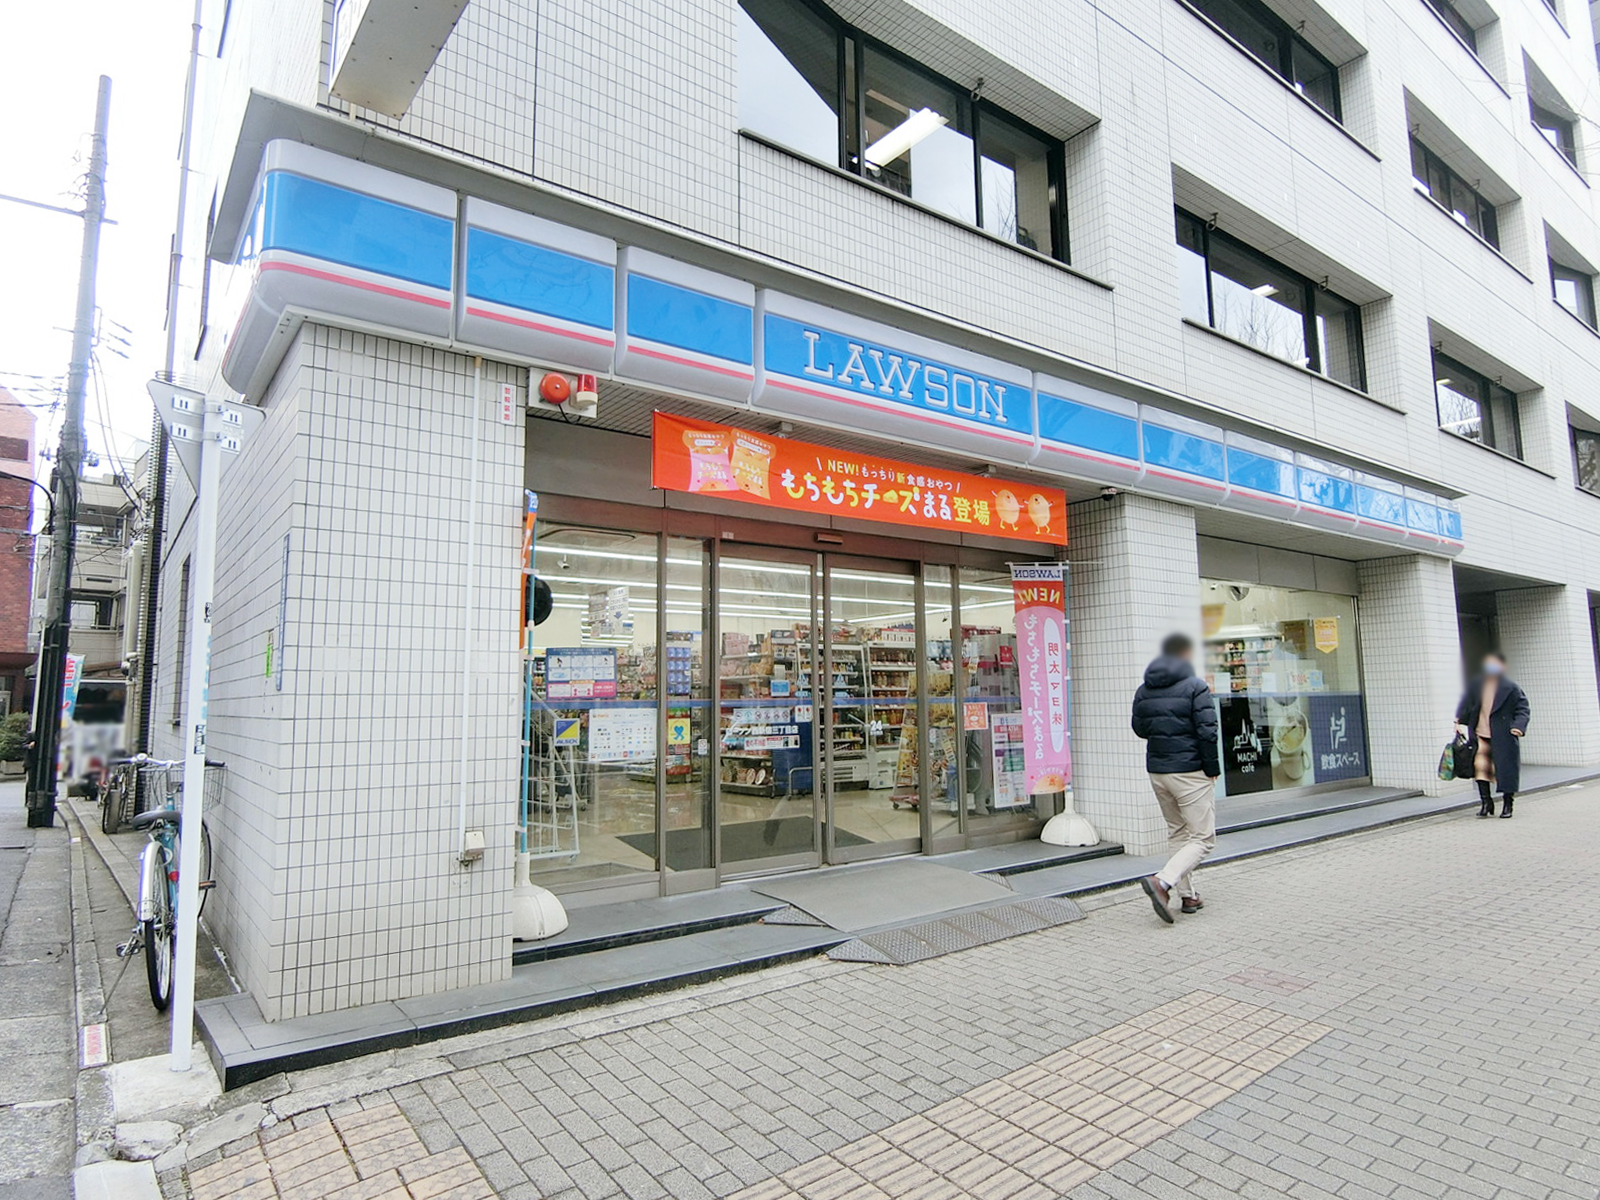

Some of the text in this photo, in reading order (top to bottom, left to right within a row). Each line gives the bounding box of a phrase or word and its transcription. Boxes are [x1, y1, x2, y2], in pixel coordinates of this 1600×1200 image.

[803, 329, 1008, 424] LAWSON
[827, 459, 954, 491] NEW! もっちり新食感おやつ
[870, 720, 883, 731] 24
[1237, 752, 1258, 763] MACHI
[1321, 752, 1361, 770] 飲食スペース
